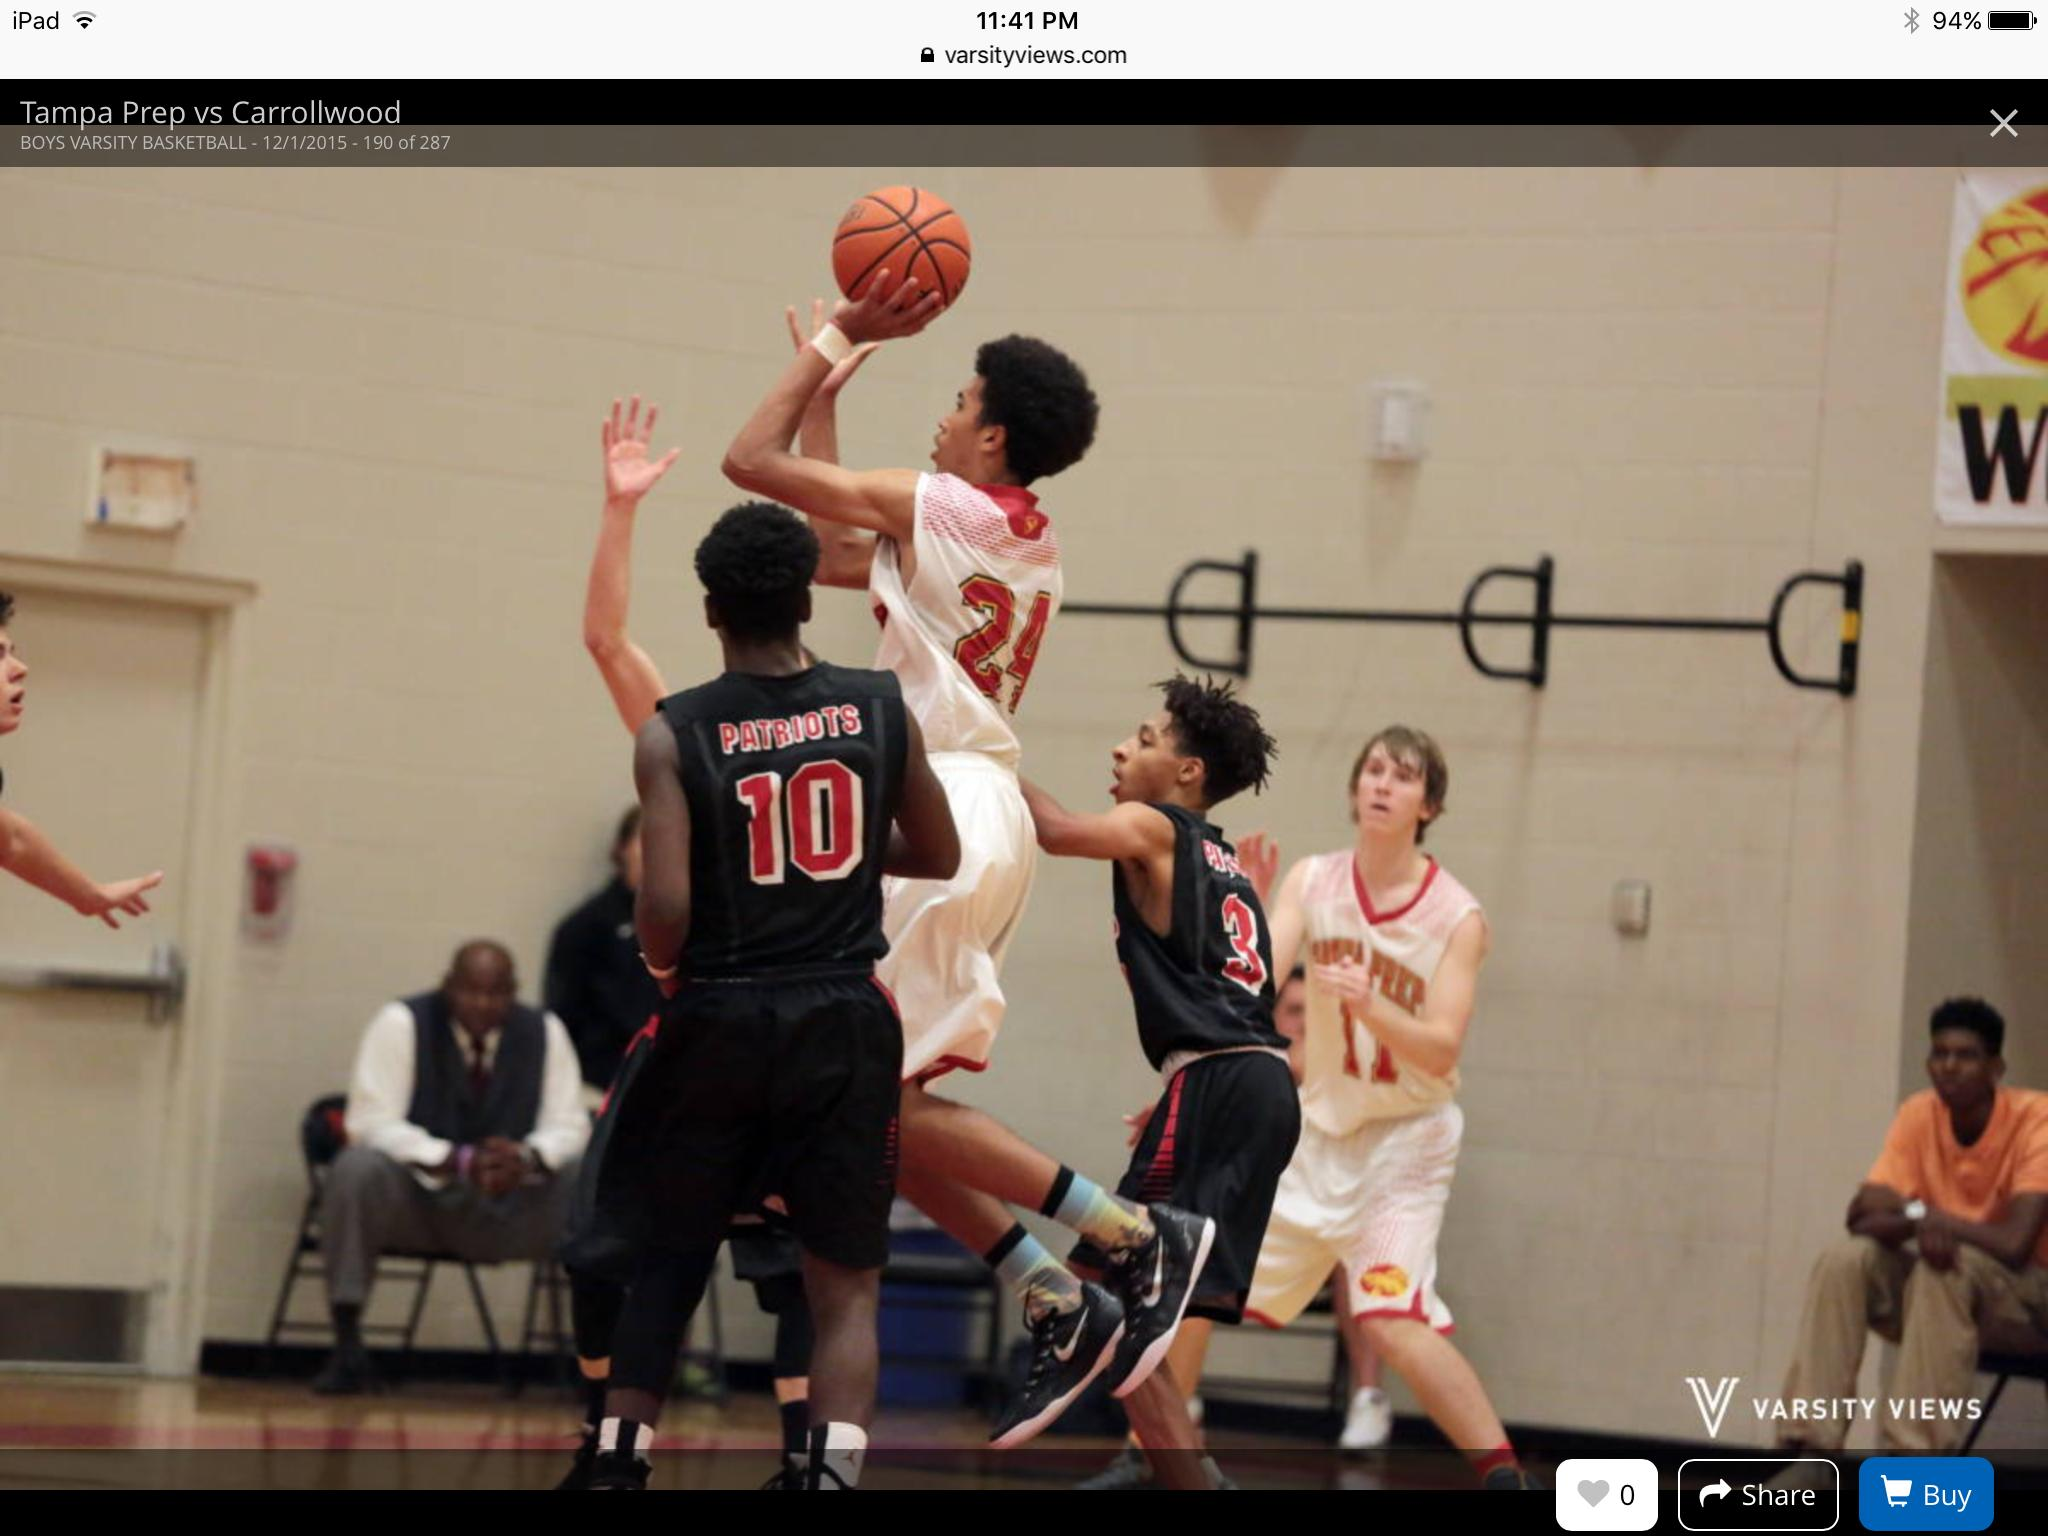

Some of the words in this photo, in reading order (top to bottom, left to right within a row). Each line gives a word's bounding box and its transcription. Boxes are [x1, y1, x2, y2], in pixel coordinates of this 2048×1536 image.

[1956, 403, 2048, 504] W
[954, 573, 1051, 714] 24
[718, 704, 863, 754] PATRIOTS
[736, 759, 863, 885] 10
[1221, 893, 1267, 997] 3
